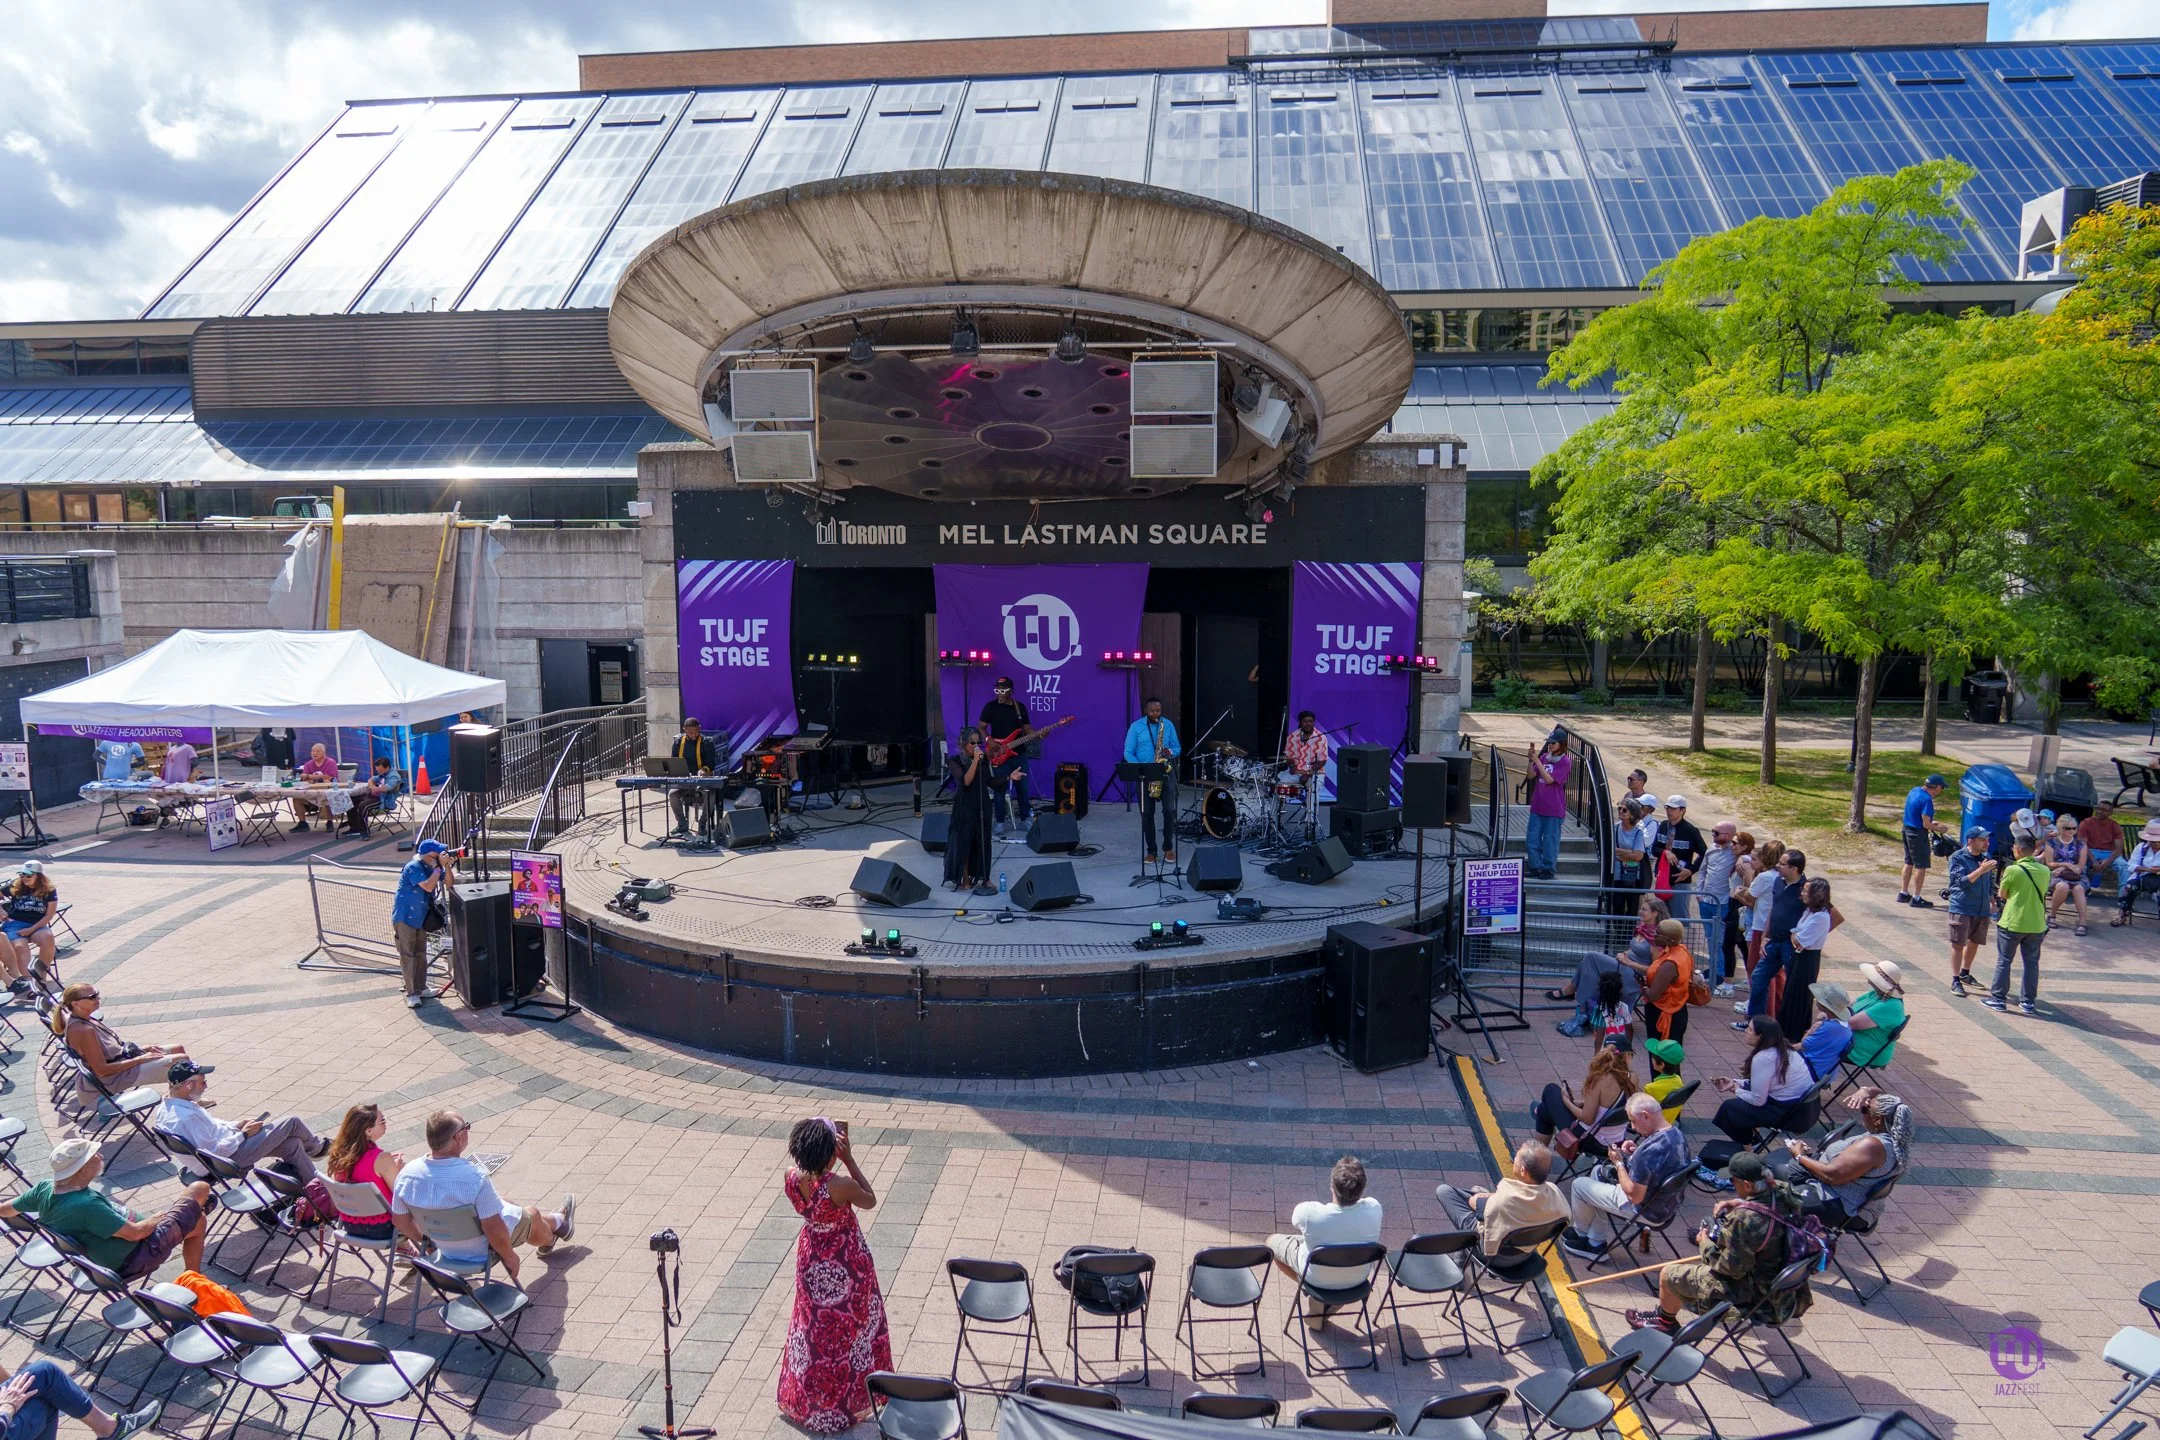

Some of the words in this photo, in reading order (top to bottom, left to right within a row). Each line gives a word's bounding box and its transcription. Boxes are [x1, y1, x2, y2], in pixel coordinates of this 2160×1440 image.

[839, 521, 906, 545] TORONTO
[939, 524, 995, 545] MEL
[1004, 524, 1138, 545] LASTMAN
[1149, 524, 1267, 545] SQUARE
[699, 618, 769, 643] TUJF
[1316, 624, 1394, 650] TUJF
[700, 646, 770, 667] STAGE
[1314, 652, 1392, 676] STAGE
[1026, 674, 1061, 694] JAZZ
[1030, 696, 1057, 712] FEST
[118, 727, 183, 738] HEADQUARTERS
